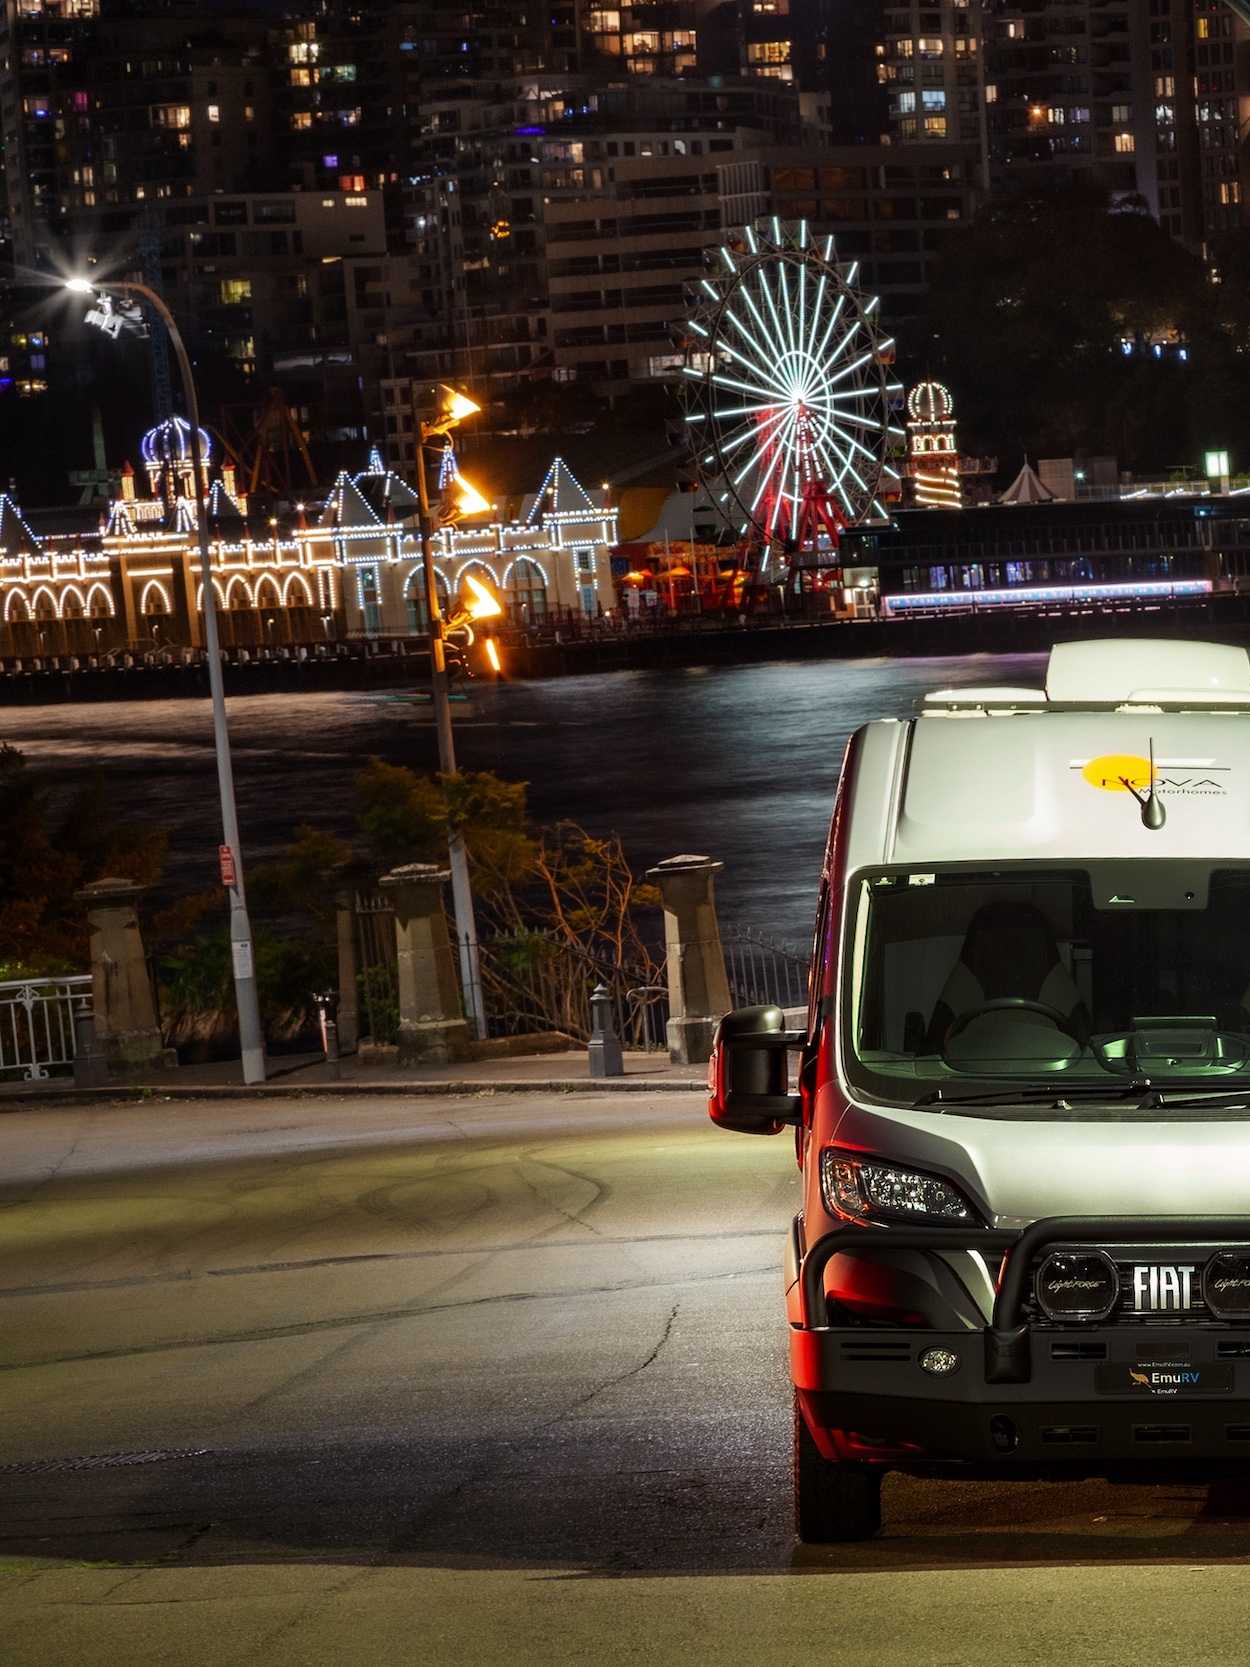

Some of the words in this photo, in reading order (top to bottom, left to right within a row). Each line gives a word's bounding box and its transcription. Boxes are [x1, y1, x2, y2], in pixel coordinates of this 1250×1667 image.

[1101, 778, 1223, 788] NOVA
[1133, 1265, 1195, 1310] FIAT
[1151, 1371, 1201, 1384] EmuRV
